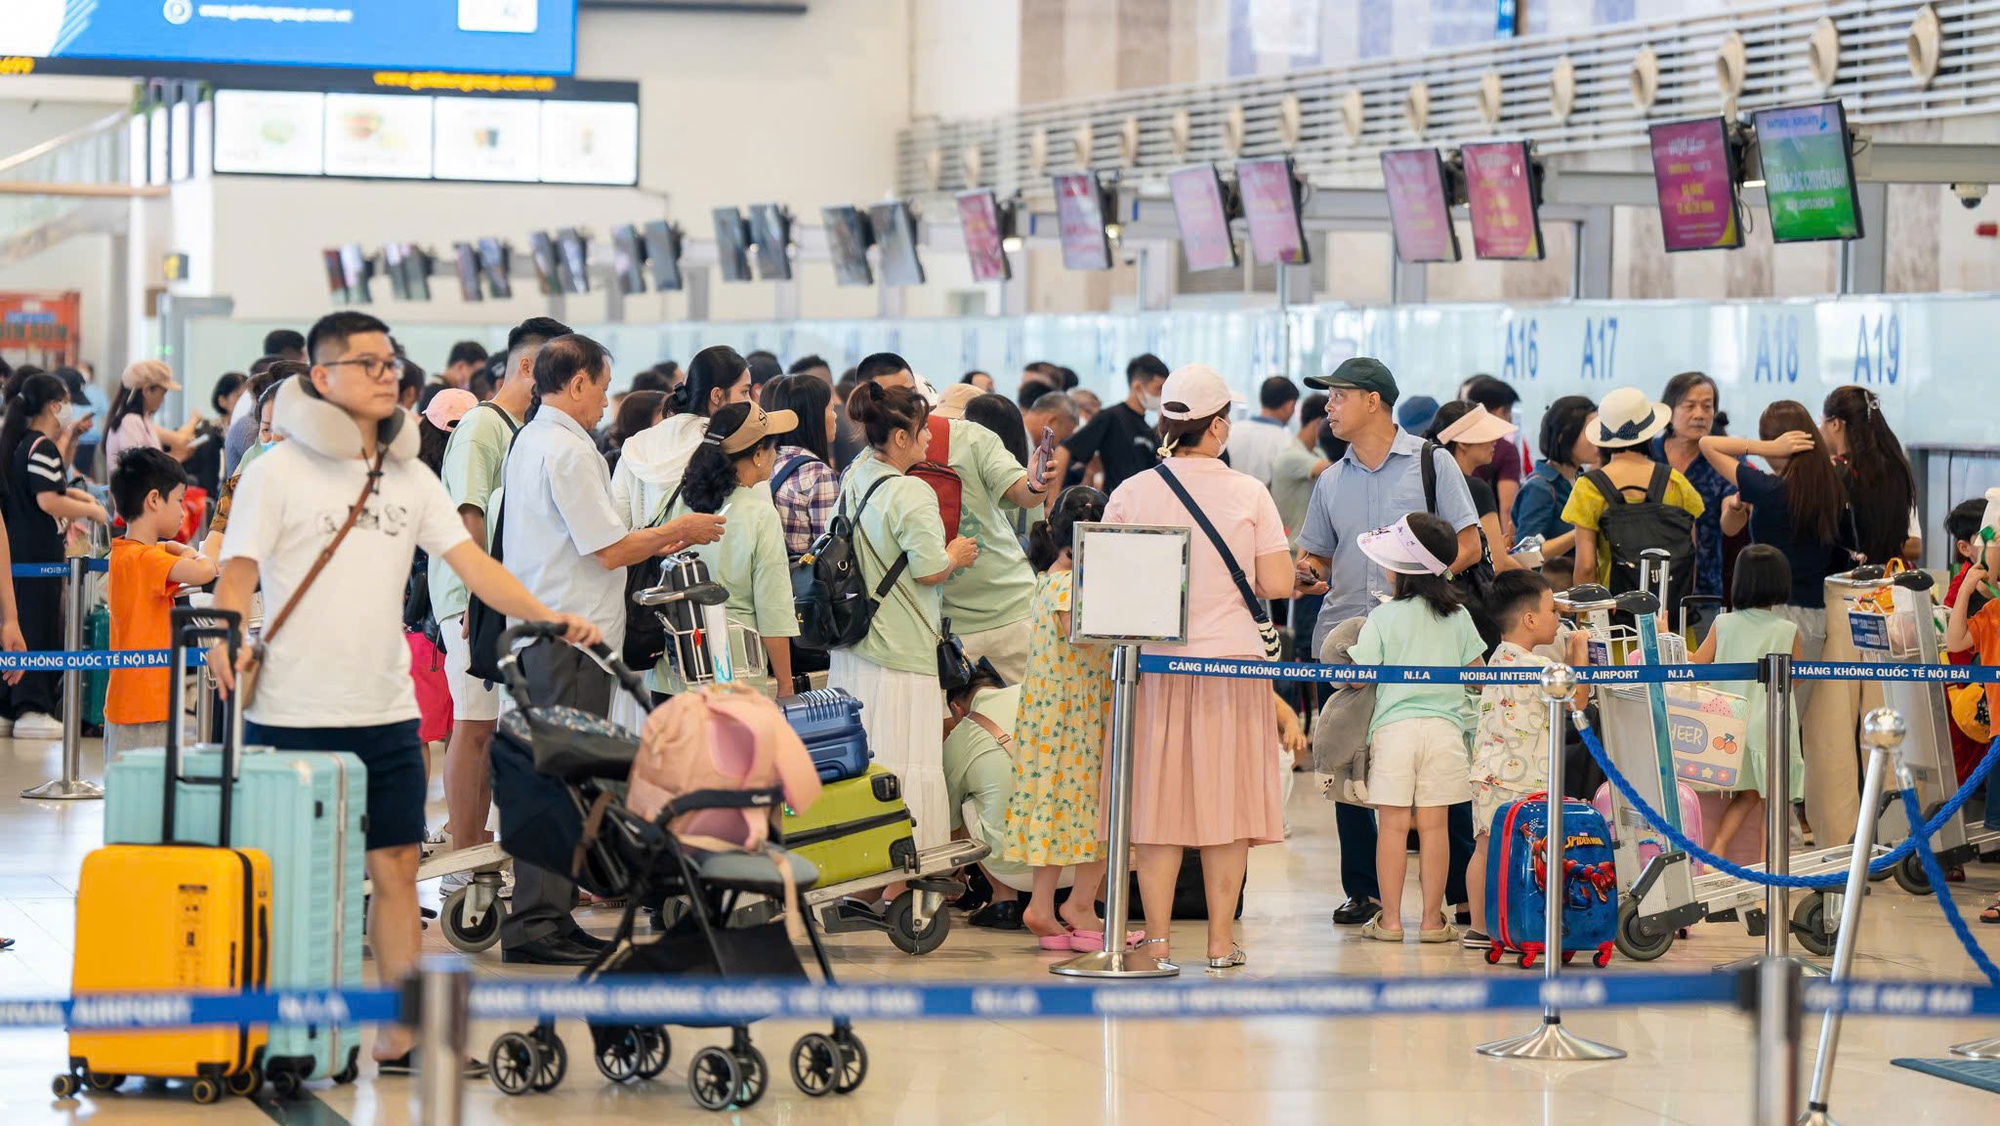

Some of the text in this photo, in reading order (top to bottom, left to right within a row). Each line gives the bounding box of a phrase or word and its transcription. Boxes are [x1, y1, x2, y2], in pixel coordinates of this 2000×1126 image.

[1504, 318, 1538, 380] A16
[1581, 316, 1618, 379] A17
[1754, 314, 1799, 384] A18
[1853, 313, 1900, 385] A19
[41, 566, 69, 574] NOIBA
[20, 654, 63, 667] KHÔNG
[67, 653, 102, 667] QUỐC
[106, 652, 121, 665] TẾ
[123, 652, 145, 667] NỘI
[148, 652, 168, 664] BÀI
[1168, 658, 1694, 681] CẢNG HÀNG KHÔNG QUỐC TẾ NỘI BÀI N.I.A NOIBAI INTERNAL AIRPORT N.I.A
[1798, 664, 1831, 676] HÀNG
[1833, 665, 1874, 677] KHÔNG
[1876, 664, 1909, 678] QUỐC
[1911, 665, 1926, 678] TẾ
[1927, 667, 1947, 680] NỘI
[1950, 667, 1969, 679] BÀI
